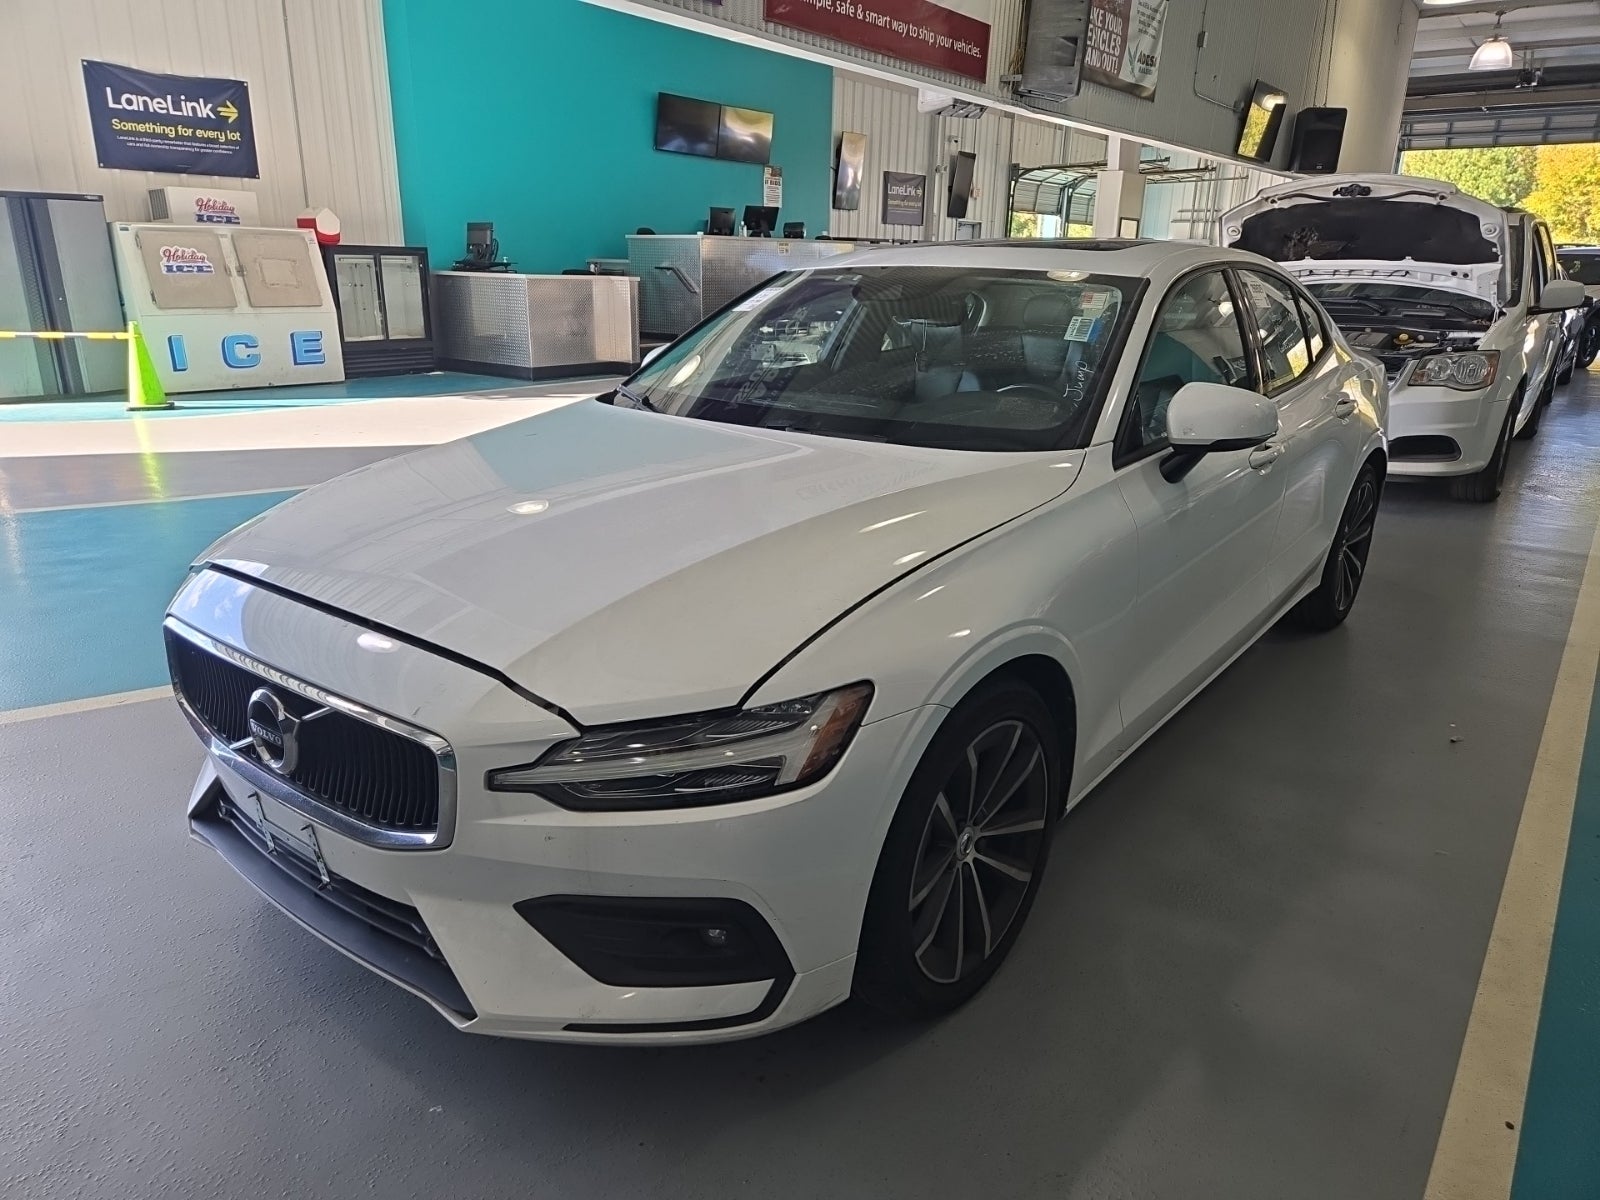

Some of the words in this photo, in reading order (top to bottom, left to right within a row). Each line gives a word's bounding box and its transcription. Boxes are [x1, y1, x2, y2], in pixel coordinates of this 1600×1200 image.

[799, 0, 834, 13] ple,
[835, 0, 855, 18] safe
[856, 3, 864, 20] &
[865, 10, 890, 29] smart
[891, 19, 909, 38] way
[909, 22, 918, 38] to
[918, 25, 935, 46] ship
[935, 33, 953, 49] your
[953, 38, 983, 59] vehicles.
[1090, 5, 1105, 28] AKE
[1104, 11, 1123, 35] YOUR
[1086, 23, 1122, 57] EHICLES
[1101, 52, 1120, 75] OUT!
[105, 87, 217, 120] LaneLink
[111, 118, 176, 138] Something
[177, 124, 193, 137] for
[195, 127, 225, 143] every
[226, 130, 241, 142] lot
[887, 183, 916, 197] LaneLink
[195, 198, 236, 214] Holiday
[163, 247, 207, 263] Holiday
[250, 722, 282, 745] VOLVO
